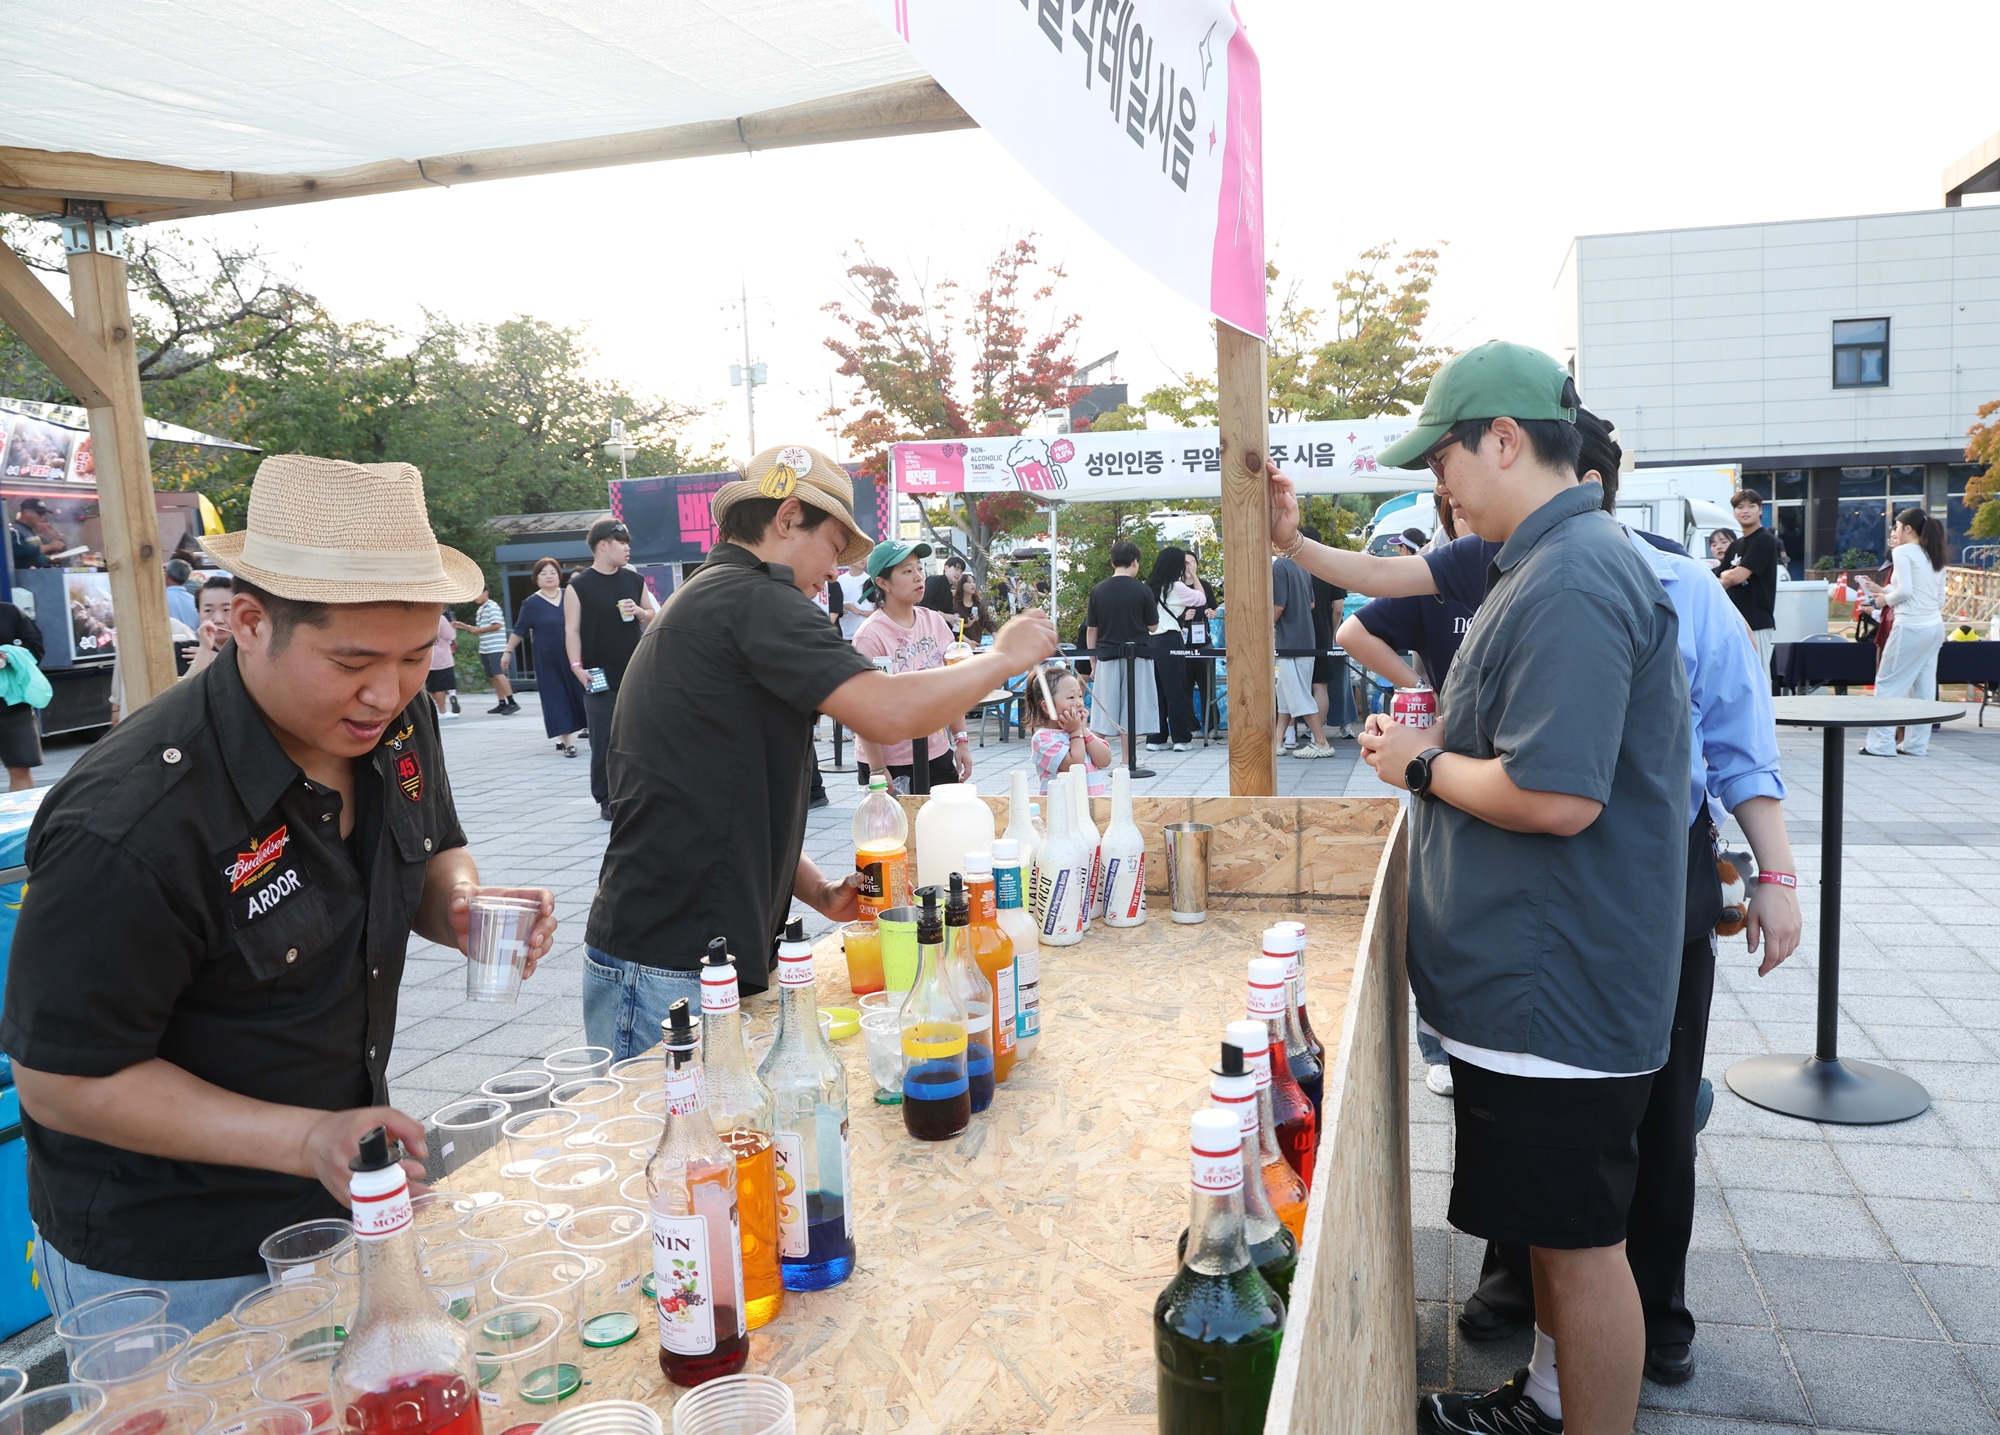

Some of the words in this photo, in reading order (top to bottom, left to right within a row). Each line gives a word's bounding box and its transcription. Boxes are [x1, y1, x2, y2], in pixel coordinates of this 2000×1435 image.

[1054, 443, 1068, 453] FREE
[1055, 449, 1072, 460] 0.0%
[1085, 450, 1164, 476] 성인인증
[1182, 448, 1220, 473] 무알
[1269, 445, 1289, 468] 주
[1294, 443, 1335, 468] 시음
[1406, 703, 1427, 712] HITE
[400, 757, 416, 778] 45
[224, 834, 290, 883] Budweiser
[865, 874, 874, 884] 닛
[1135, 862, 1144, 893] ORIGINAL
[248, 869, 304, 920] ARDOR
[1037, 875, 1052, 930] FLAIRCO
[859, 904, 878, 916] 오렌지
[1045, 916, 1055, 934] Practice
[1053, 885, 1065, 913] Performance
[784, 971, 812, 980] MONIN
[720, 995, 739, 1004] MON
[1247, 999, 1266, 1008] ONIN
[1203, 1171, 1241, 1184] MONIN
[373, 1207, 411, 1229] MONIN
[668, 1227, 680, 1235] de
[652, 1230, 690, 1251] NIN
[482, 1395, 498, 1403] View
[222, 1424, 243, 1435] View
